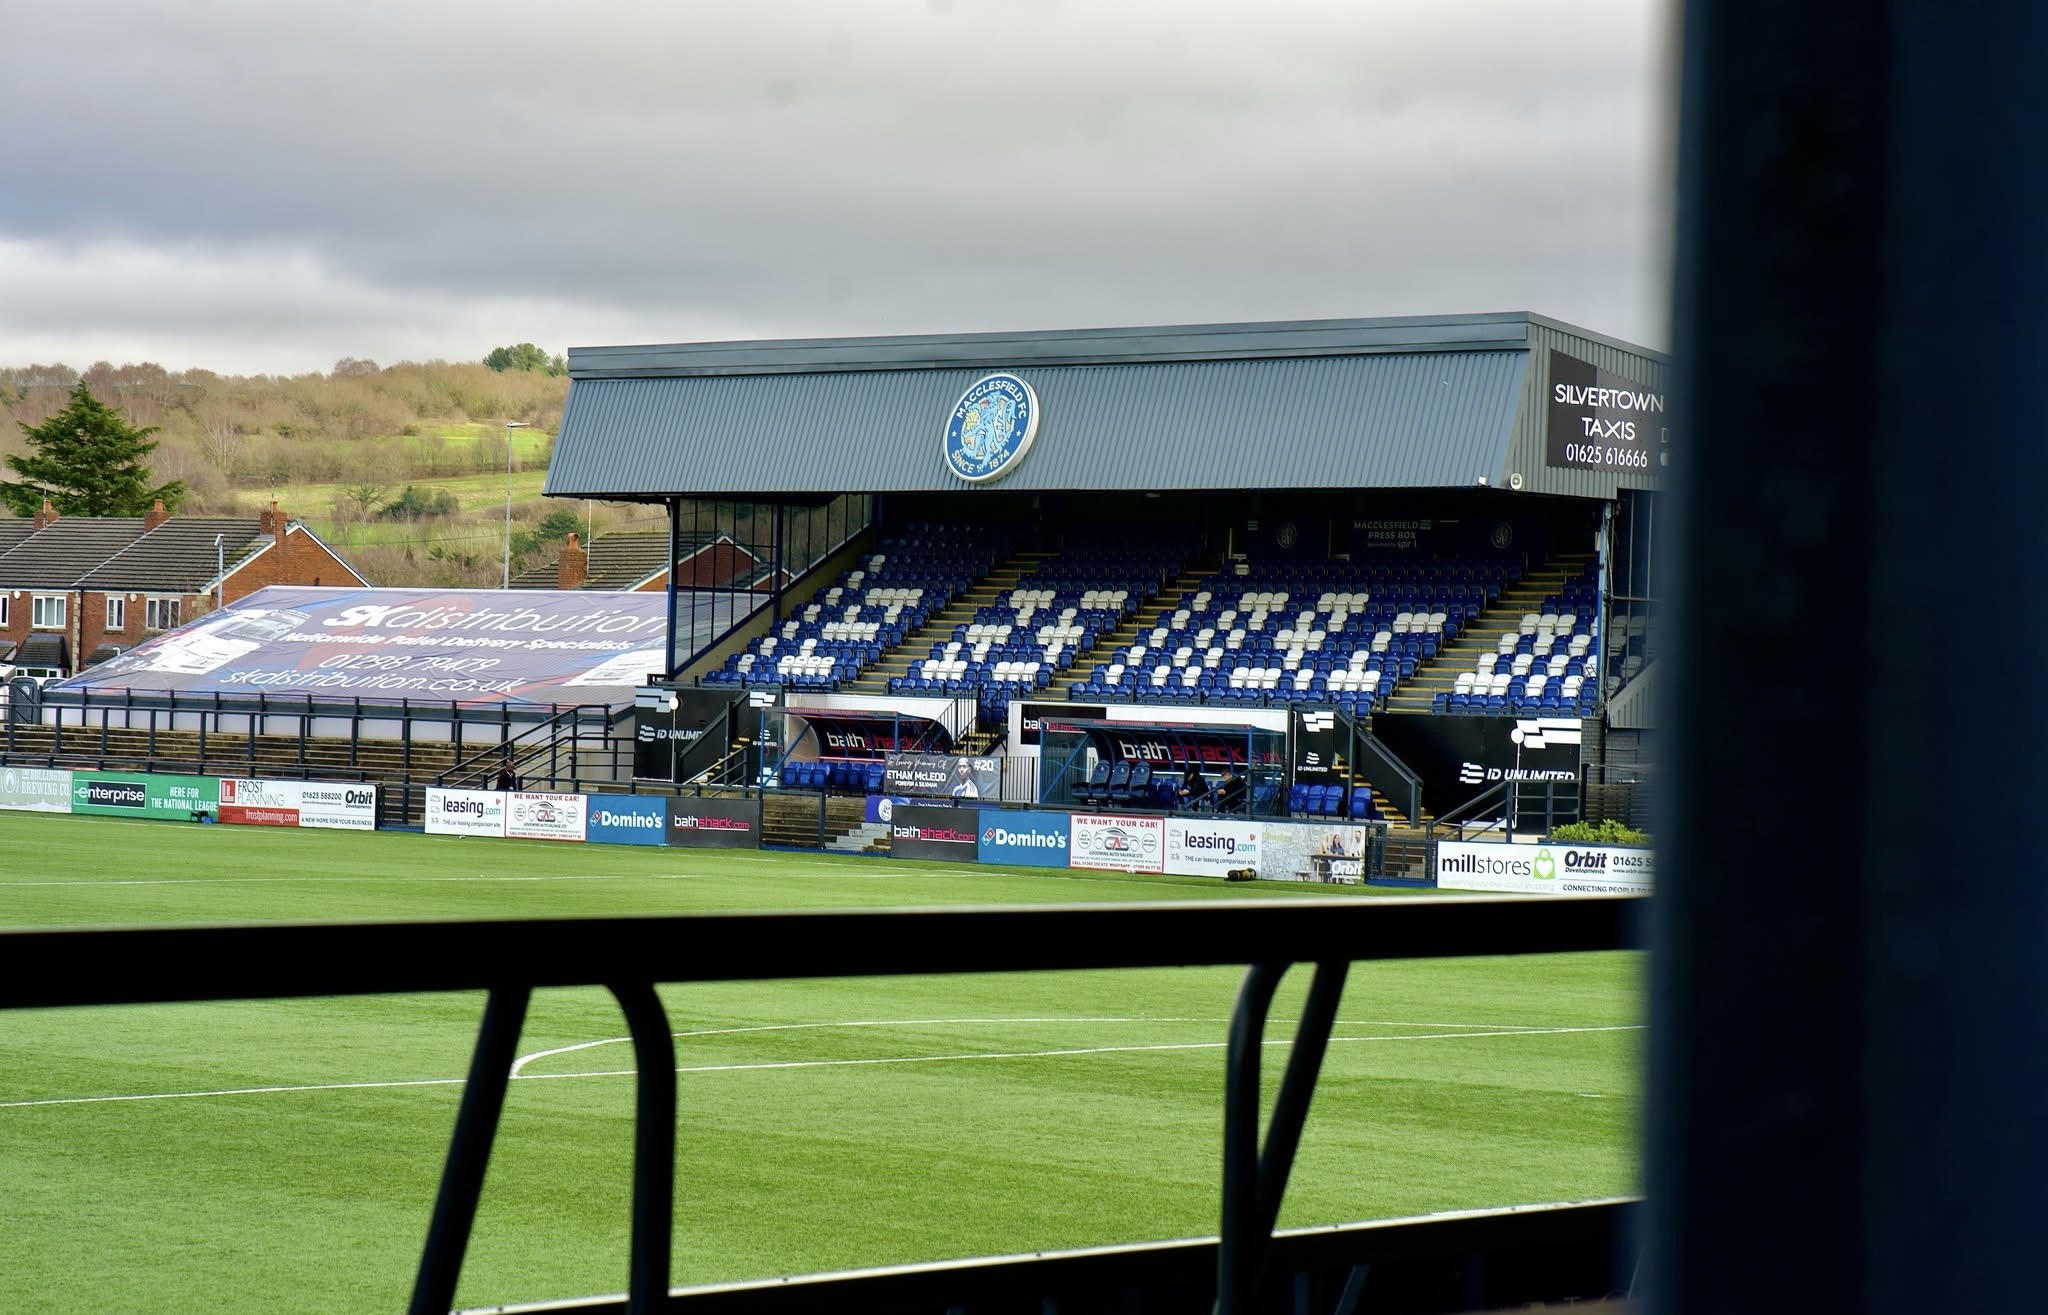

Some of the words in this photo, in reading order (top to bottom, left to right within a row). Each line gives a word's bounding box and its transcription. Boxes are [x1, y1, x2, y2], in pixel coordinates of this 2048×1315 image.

[956, 380, 1023, 419] MACCLESFIELD
[1017, 403, 1027, 420] FC
[1554, 383, 1664, 413] SILVERTOWN
[1581, 416, 1636, 441] TAXIS
[951, 449, 975, 473] SINCE
[988, 449, 1010, 470] 1874
[1566, 443, 1601, 464] 01625
[1606, 446, 1648, 468] 616666
[1354, 521, 1419, 529] MACCLESFIELD
[1368, 531, 1396, 539] PRESS
[1397, 531, 1416, 539] BOX
[283, 631, 386, 645] Nationwide
[386, 635, 446, 647] Pallet
[524, 639, 634, 651] Specialists
[318, 654, 413, 671] 01298
[404, 656, 501, 674] 79479
[219, 668, 529, 693] skdistribution.co.uk
[656, 729, 668, 740] ID
[973, 759, 994, 772] #20
[887, 769, 914, 779] ETHAN
[914, 771, 947, 782] McLEOD
[1486, 767, 1502, 780] ID
[1504, 768, 1575, 781] UNLIMITED
[21, 781, 59, 796] BREWING
[78, 785, 145, 803] enterprise
[169, 786, 187, 798] HERE
[187, 787, 199, 798] FOR
[237, 780, 265, 793] FROST
[237, 792, 285, 807] PLANNING
[302, 791, 320, 800] 01625
[345, 789, 374, 805] Orbit
[545, 794, 563, 802] YOUR
[151, 797, 163, 809] THE
[163, 798, 193, 811] NATIONAL
[194, 800, 218, 812] LEAGUE
[443, 795, 501, 818] leasing.com
[245, 808, 298, 824] frostplanning.com
[536, 809, 556, 823] GAS
[601, 810, 663, 829] Domino's
[674, 814, 750, 831] bathshack.com
[1076, 817, 1088, 825] WE
[1090, 818, 1112, 826] WANT
[1114, 818, 1137, 828] YOUR
[1139, 820, 1158, 829] CAR!
[893, 824, 976, 840] bathshack.com
[995, 828, 1067, 849] Domino's
[1104, 836, 1130, 852] GAS
[1185, 830, 1256, 857] leasing.com
[1203, 856, 1219, 865] leasing
[1219, 858, 1246, 866] comparison
[1442, 853, 1532, 876] millstores
[1564, 850, 1607, 869] Orbit
[1613, 855, 1643, 867] 01625
[1565, 866, 1606, 875] Developments
[1562, 884, 1607, 893] CONNECTING
